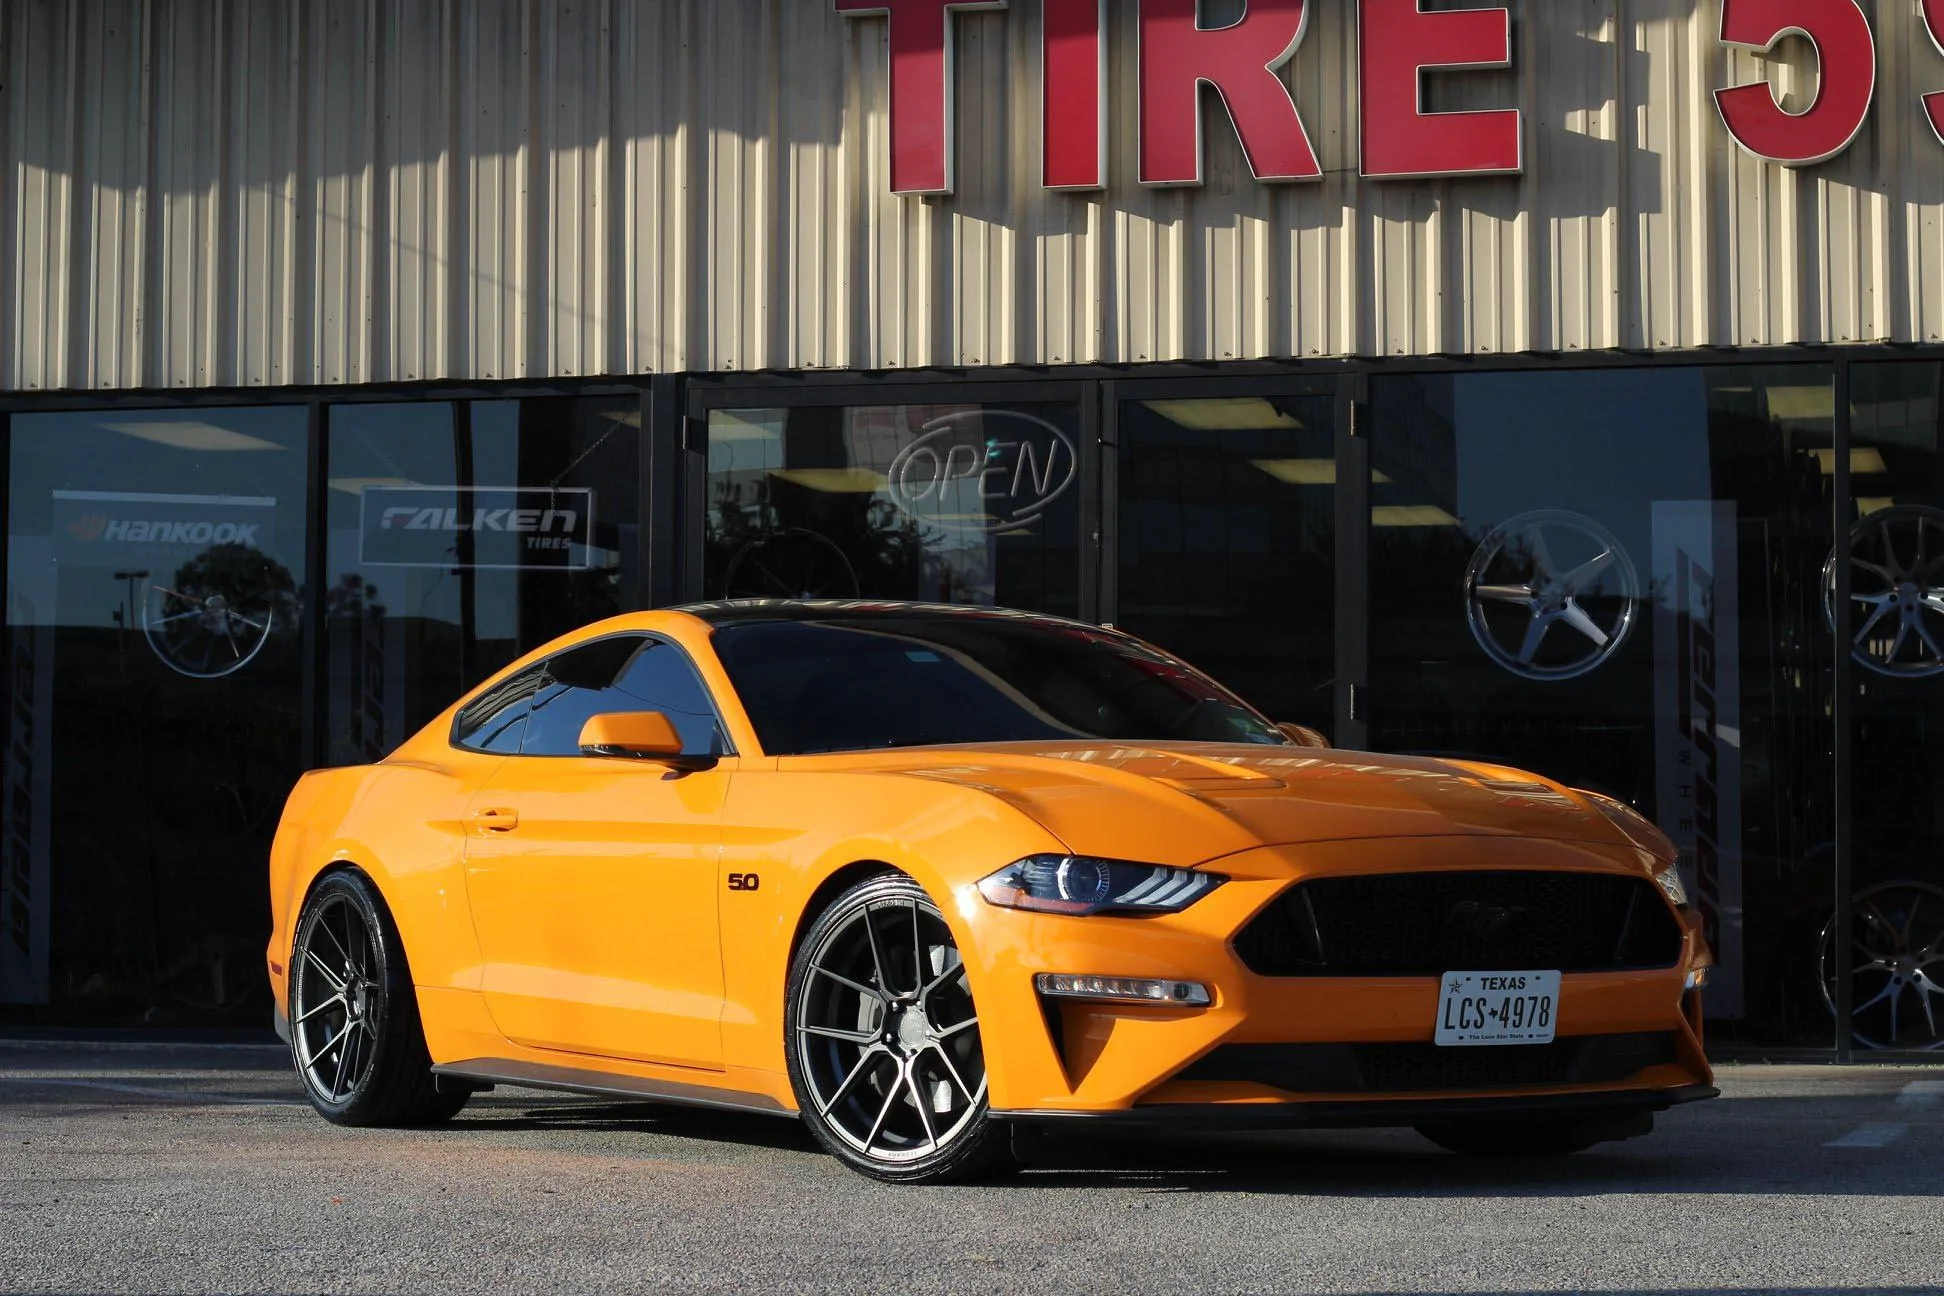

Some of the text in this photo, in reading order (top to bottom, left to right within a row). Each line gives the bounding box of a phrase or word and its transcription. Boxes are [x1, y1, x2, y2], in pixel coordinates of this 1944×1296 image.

[836, 0, 1944, 196] TIRE 5
[900, 438, 1059, 502] OPEN
[103, 519, 261, 545] HANKOOK
[379, 507, 578, 533] FALKEN
[526, 535, 572, 550] TIRES
[727, 872, 760, 891] 5.0
[1480, 976, 1526, 991] TEXAS
